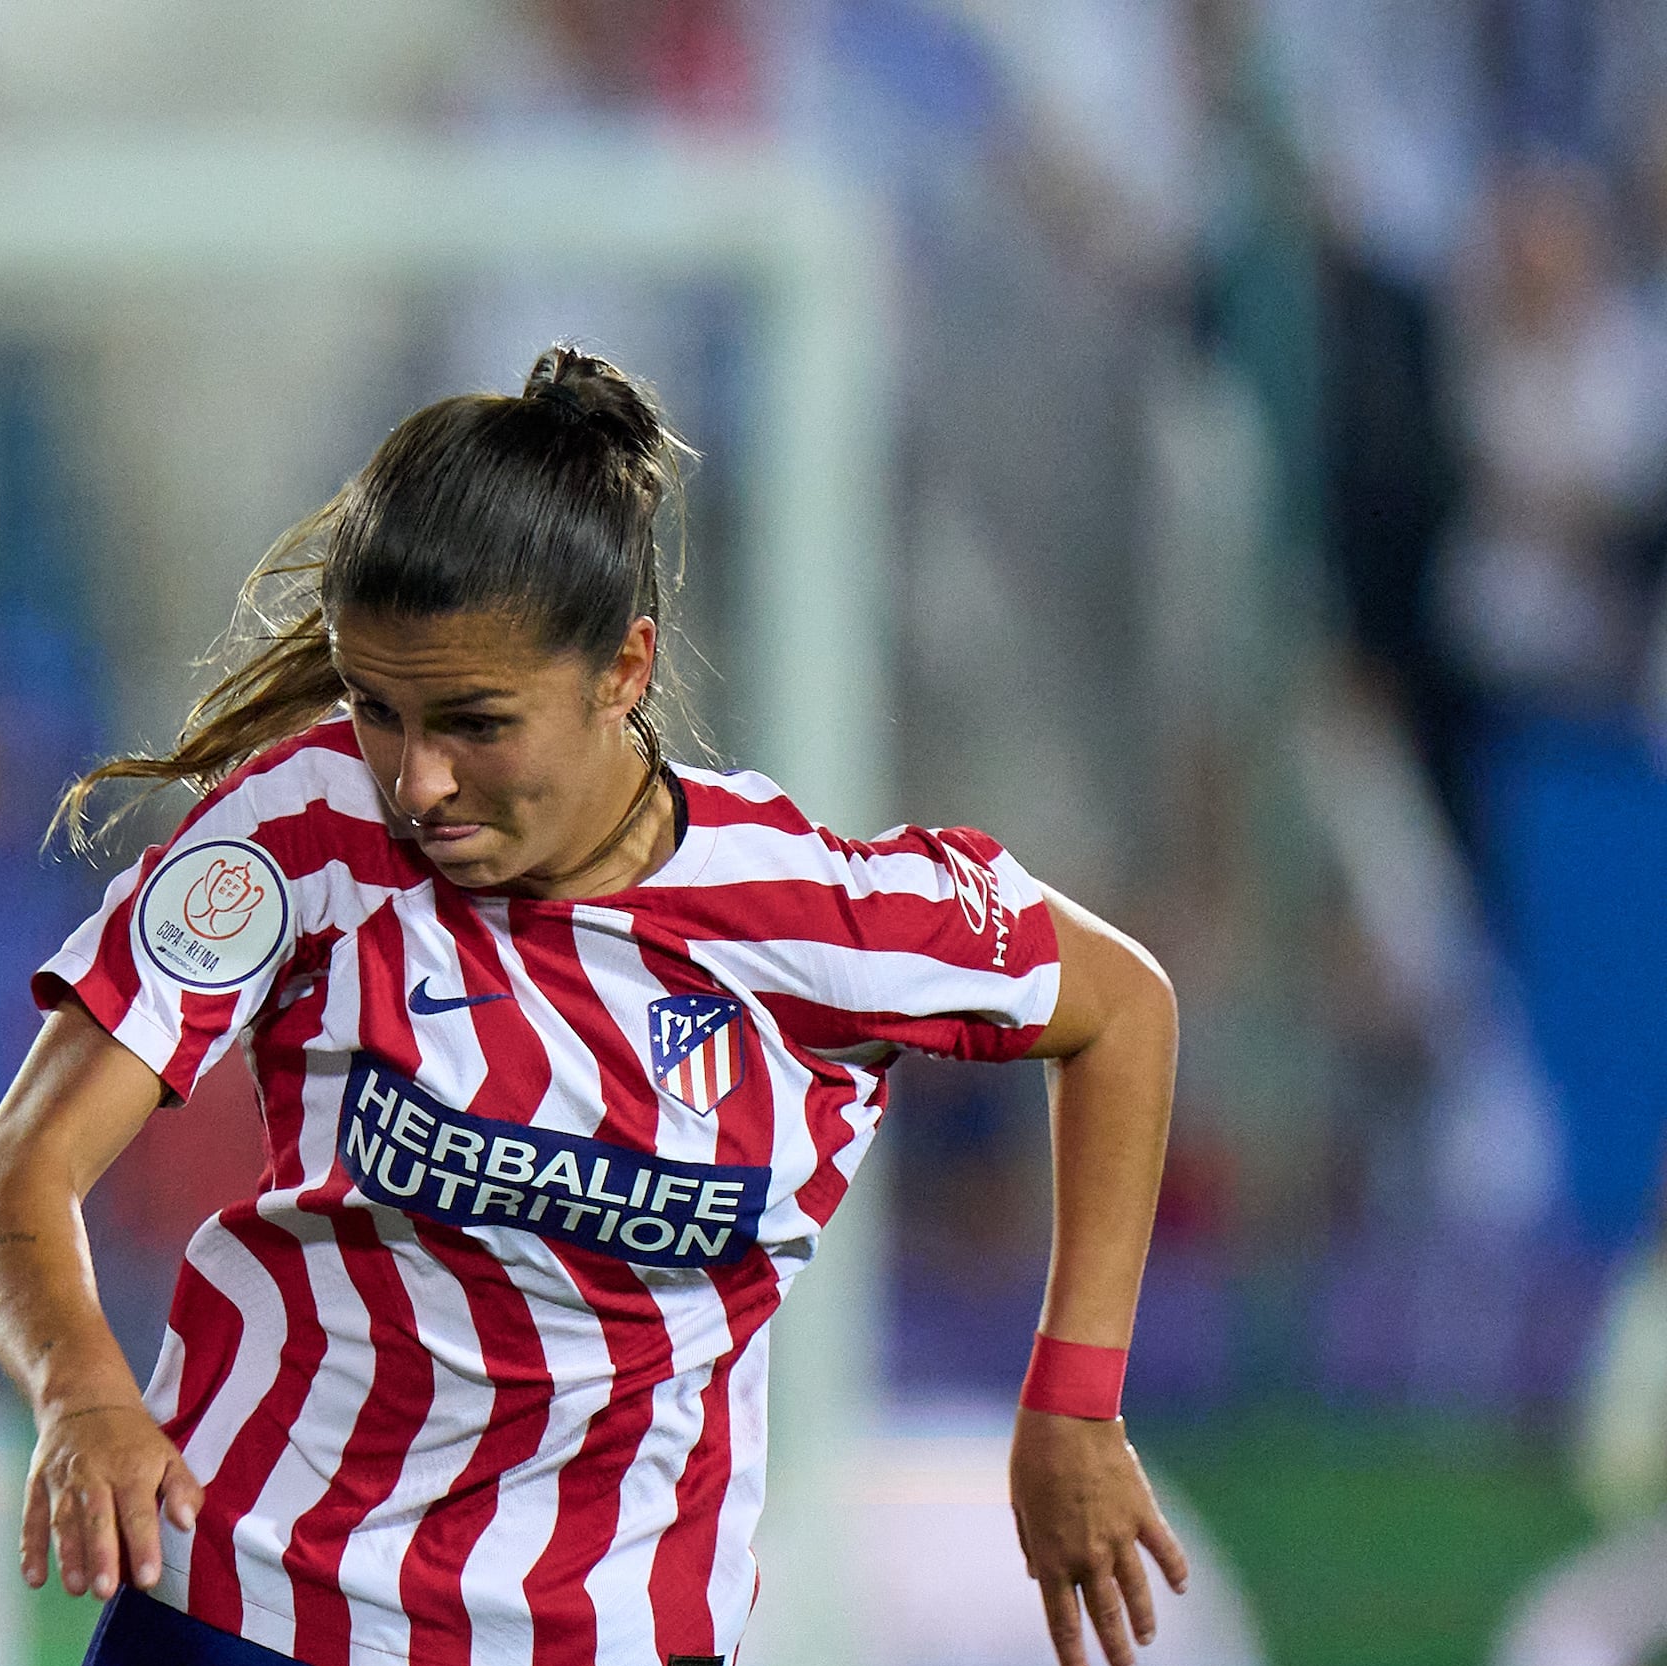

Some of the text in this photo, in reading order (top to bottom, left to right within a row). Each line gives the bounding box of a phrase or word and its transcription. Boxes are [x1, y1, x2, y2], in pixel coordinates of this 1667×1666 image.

[156, 920, 184, 948] COPA
[185, 940, 220, 974] REINA
[346, 1116, 733, 1257] NUTRITION
[357, 1068, 745, 1222] HERBALIFE
